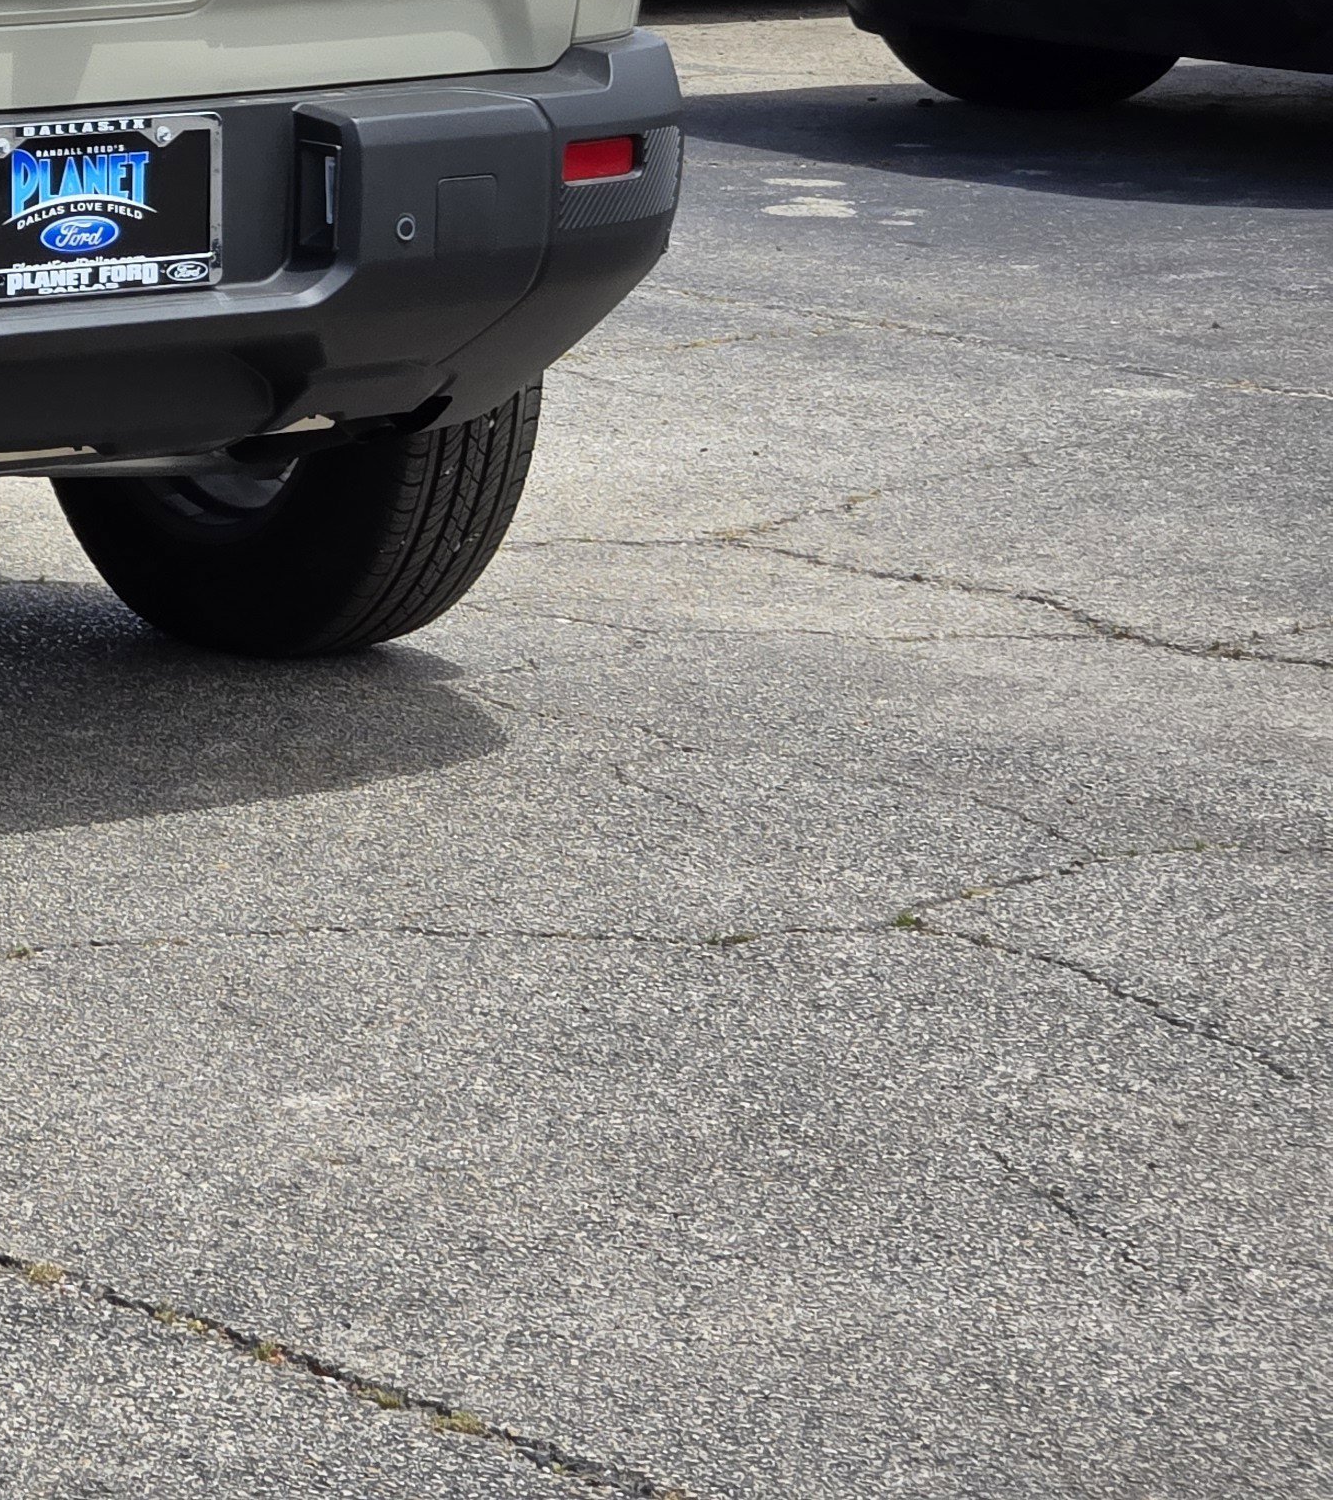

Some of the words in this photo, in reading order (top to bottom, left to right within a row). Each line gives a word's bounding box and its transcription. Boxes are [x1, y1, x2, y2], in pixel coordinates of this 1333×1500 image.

[11, 148, 150, 218] PLANET
[16, 205, 65, 231] DALLAS
[70, 202, 103, 212] LOVE
[107, 203, 144, 220] FIELD
[55, 221, 104, 248] Ford
[6, 267, 93, 296] PLANET
[99, 262, 159, 285] FORD
[174, 263, 202, 278] Ford
